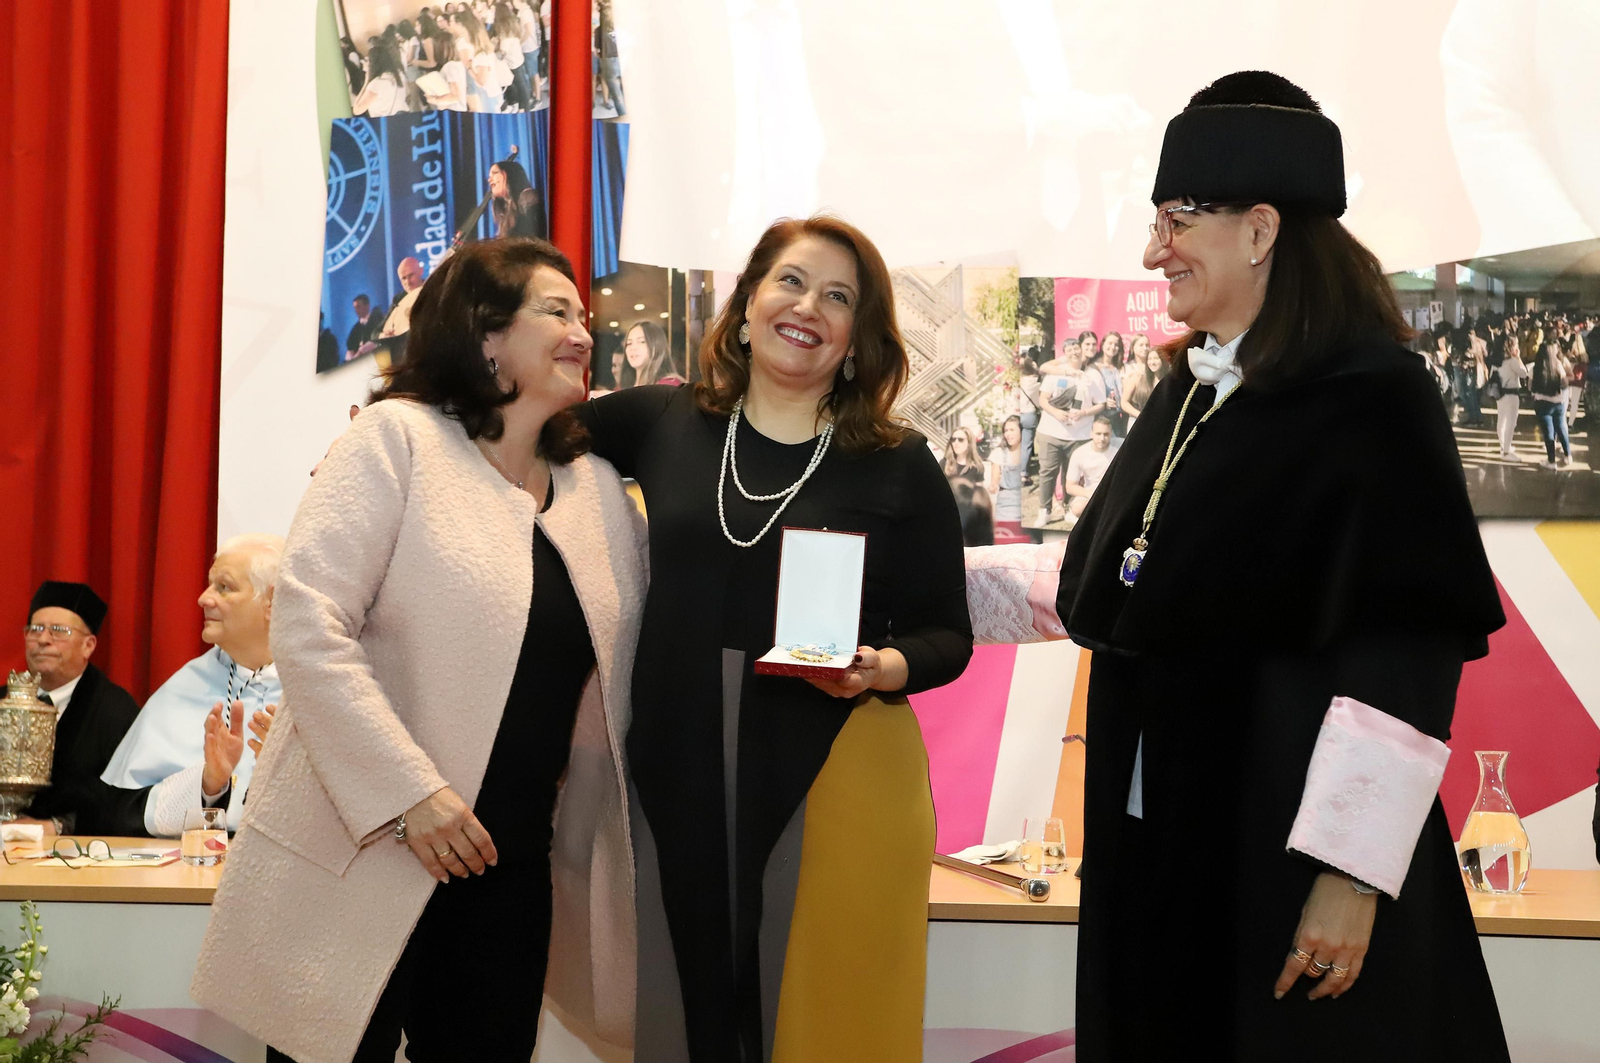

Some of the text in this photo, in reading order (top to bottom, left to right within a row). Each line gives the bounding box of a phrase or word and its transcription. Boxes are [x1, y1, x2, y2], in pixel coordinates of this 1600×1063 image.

[412, 160, 443, 200] de
[413, 203, 447, 275] idad
[1127, 315, 1149, 333] TUS
